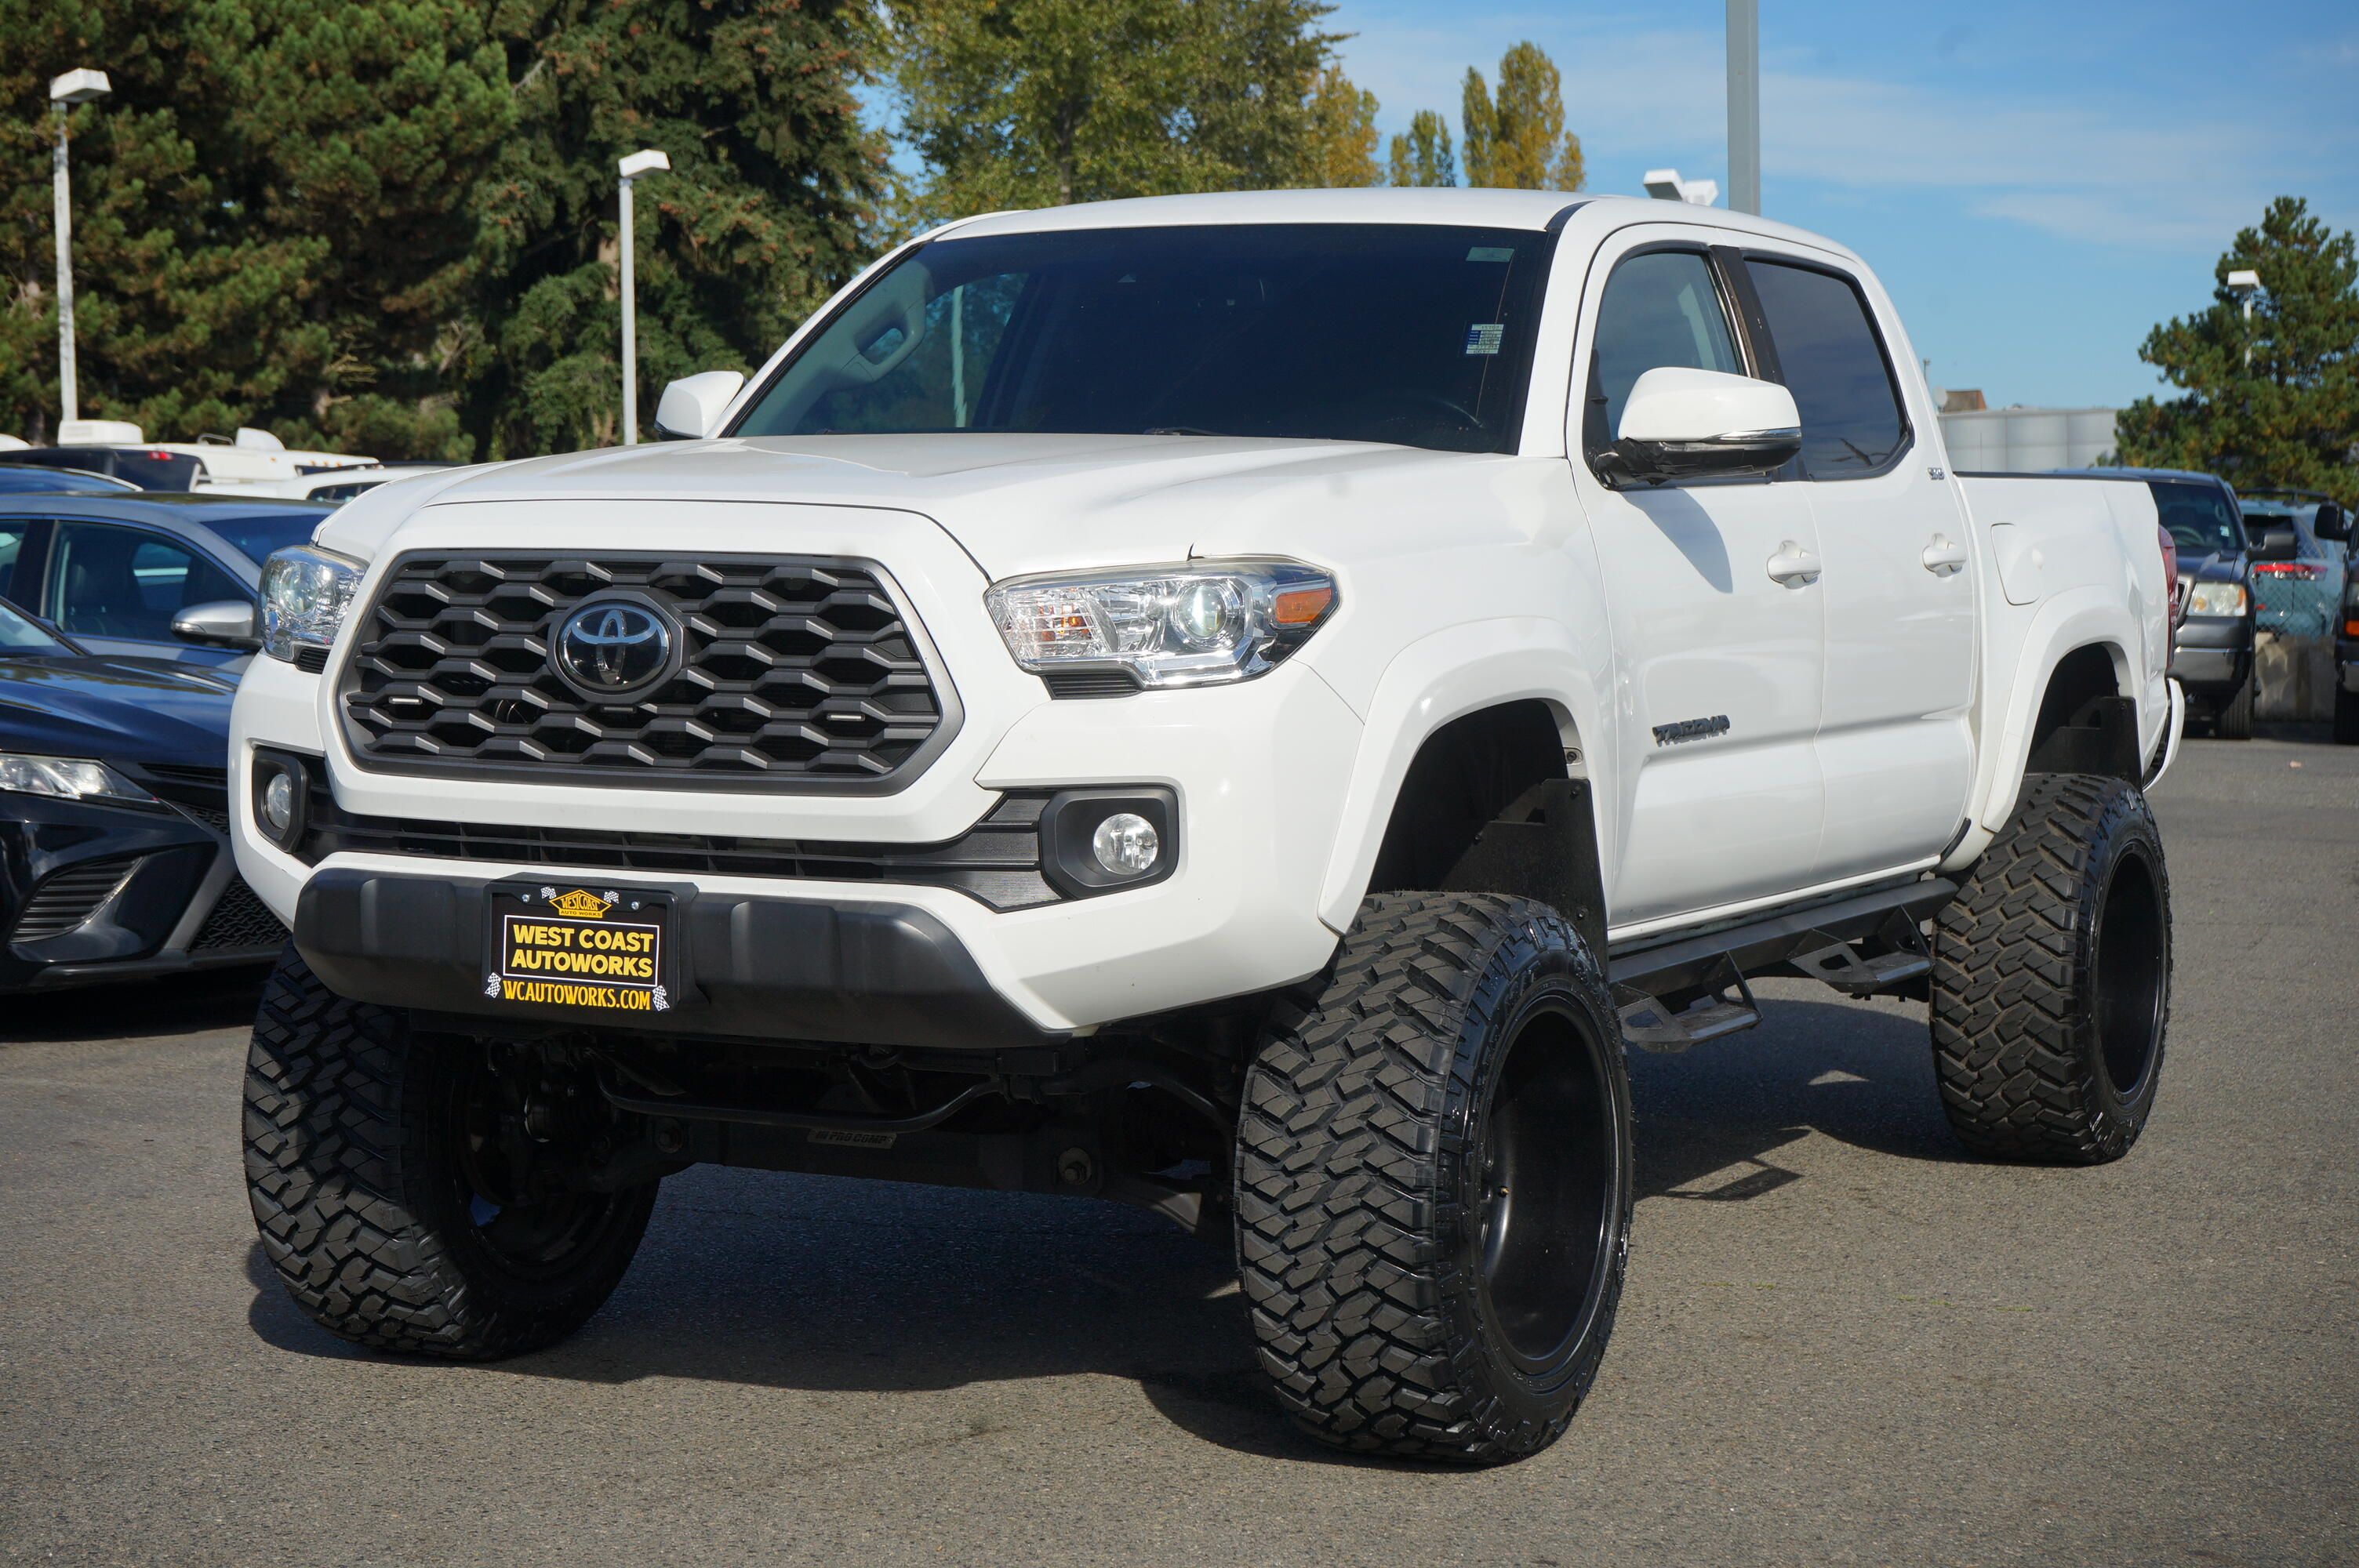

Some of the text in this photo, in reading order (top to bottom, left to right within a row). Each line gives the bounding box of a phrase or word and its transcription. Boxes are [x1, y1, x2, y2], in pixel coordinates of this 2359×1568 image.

[513, 924, 654, 953] WEST COAST
[511, 949, 653, 978] AUTOWORKS
[503, 980, 651, 1011] WCAUTOWORKS.COM
